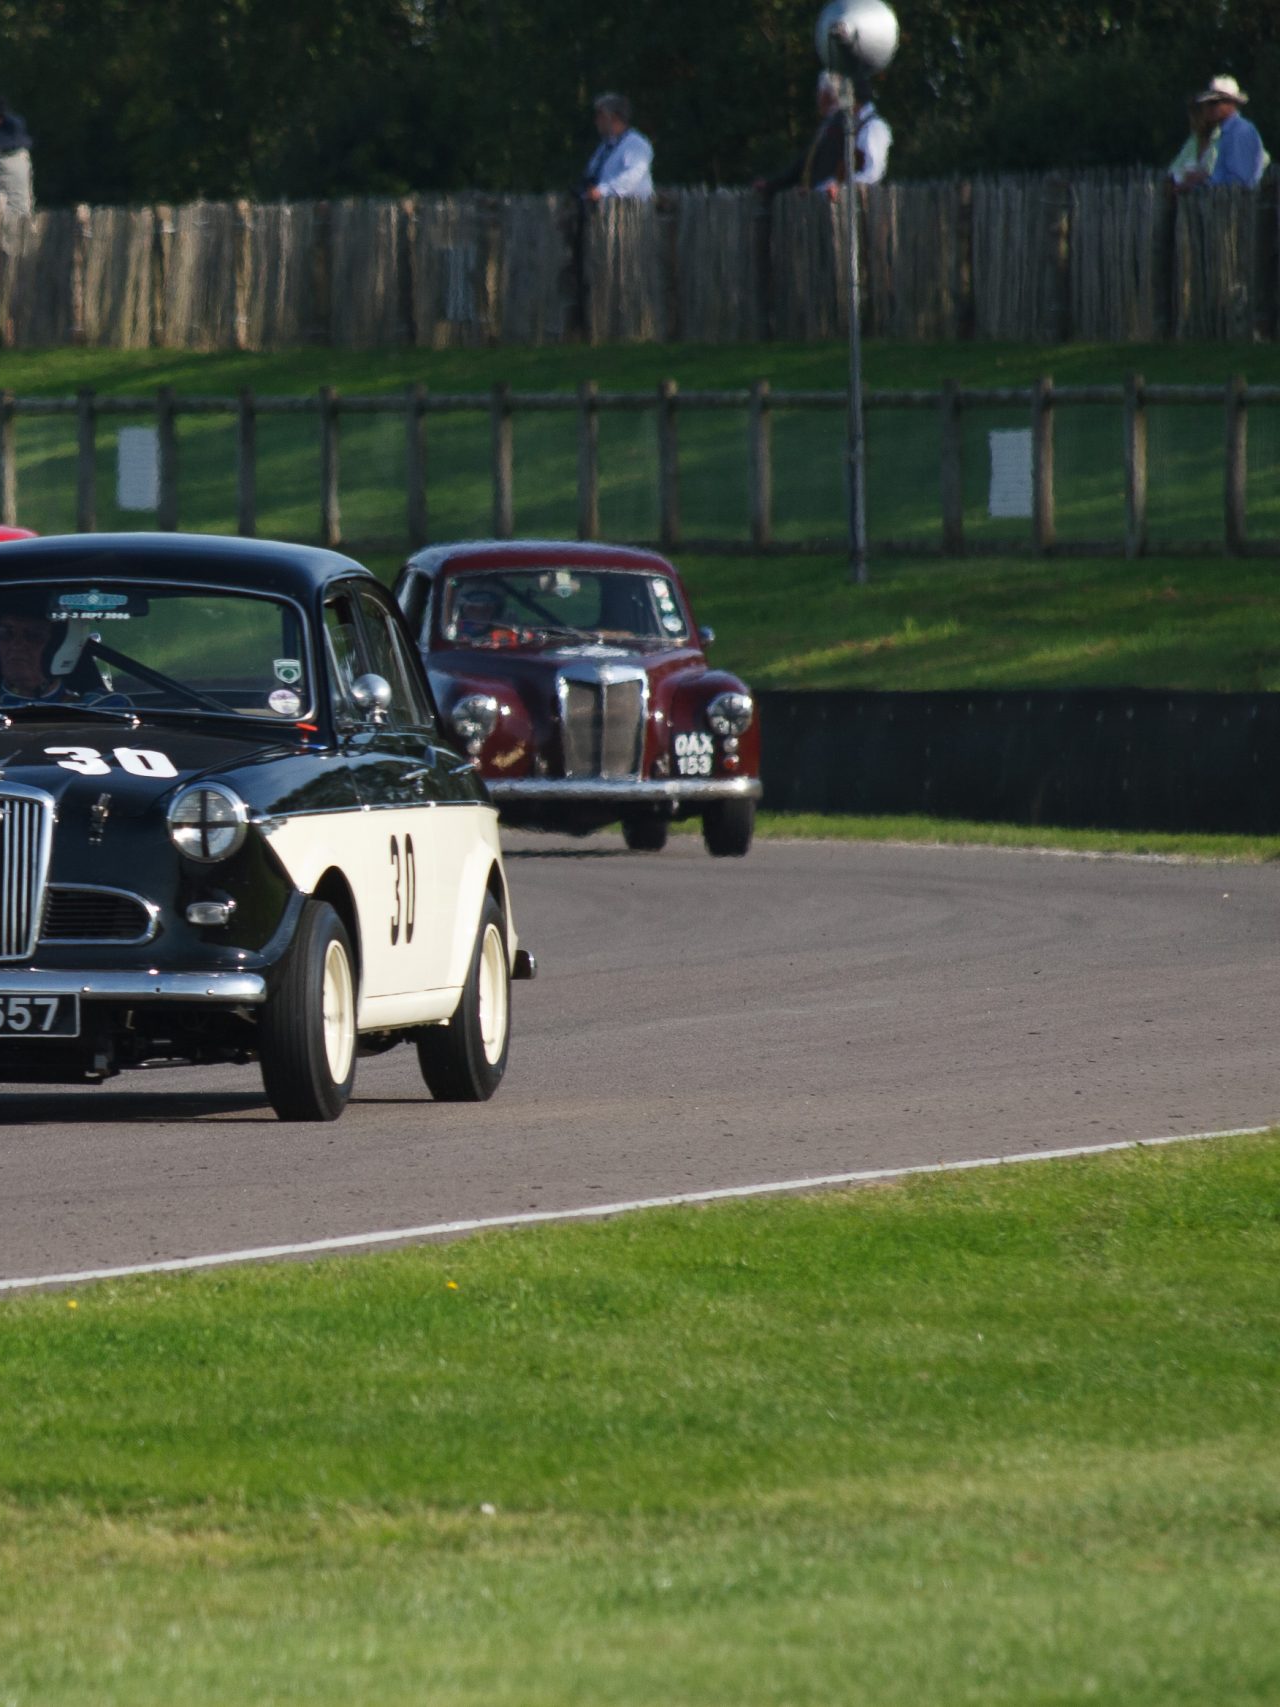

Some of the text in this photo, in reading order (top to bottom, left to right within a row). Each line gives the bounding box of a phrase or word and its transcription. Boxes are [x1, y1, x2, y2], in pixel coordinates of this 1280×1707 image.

[43, 747, 179, 778] 30
[678, 755, 712, 775] 153
[391, 833, 416, 946] 30
